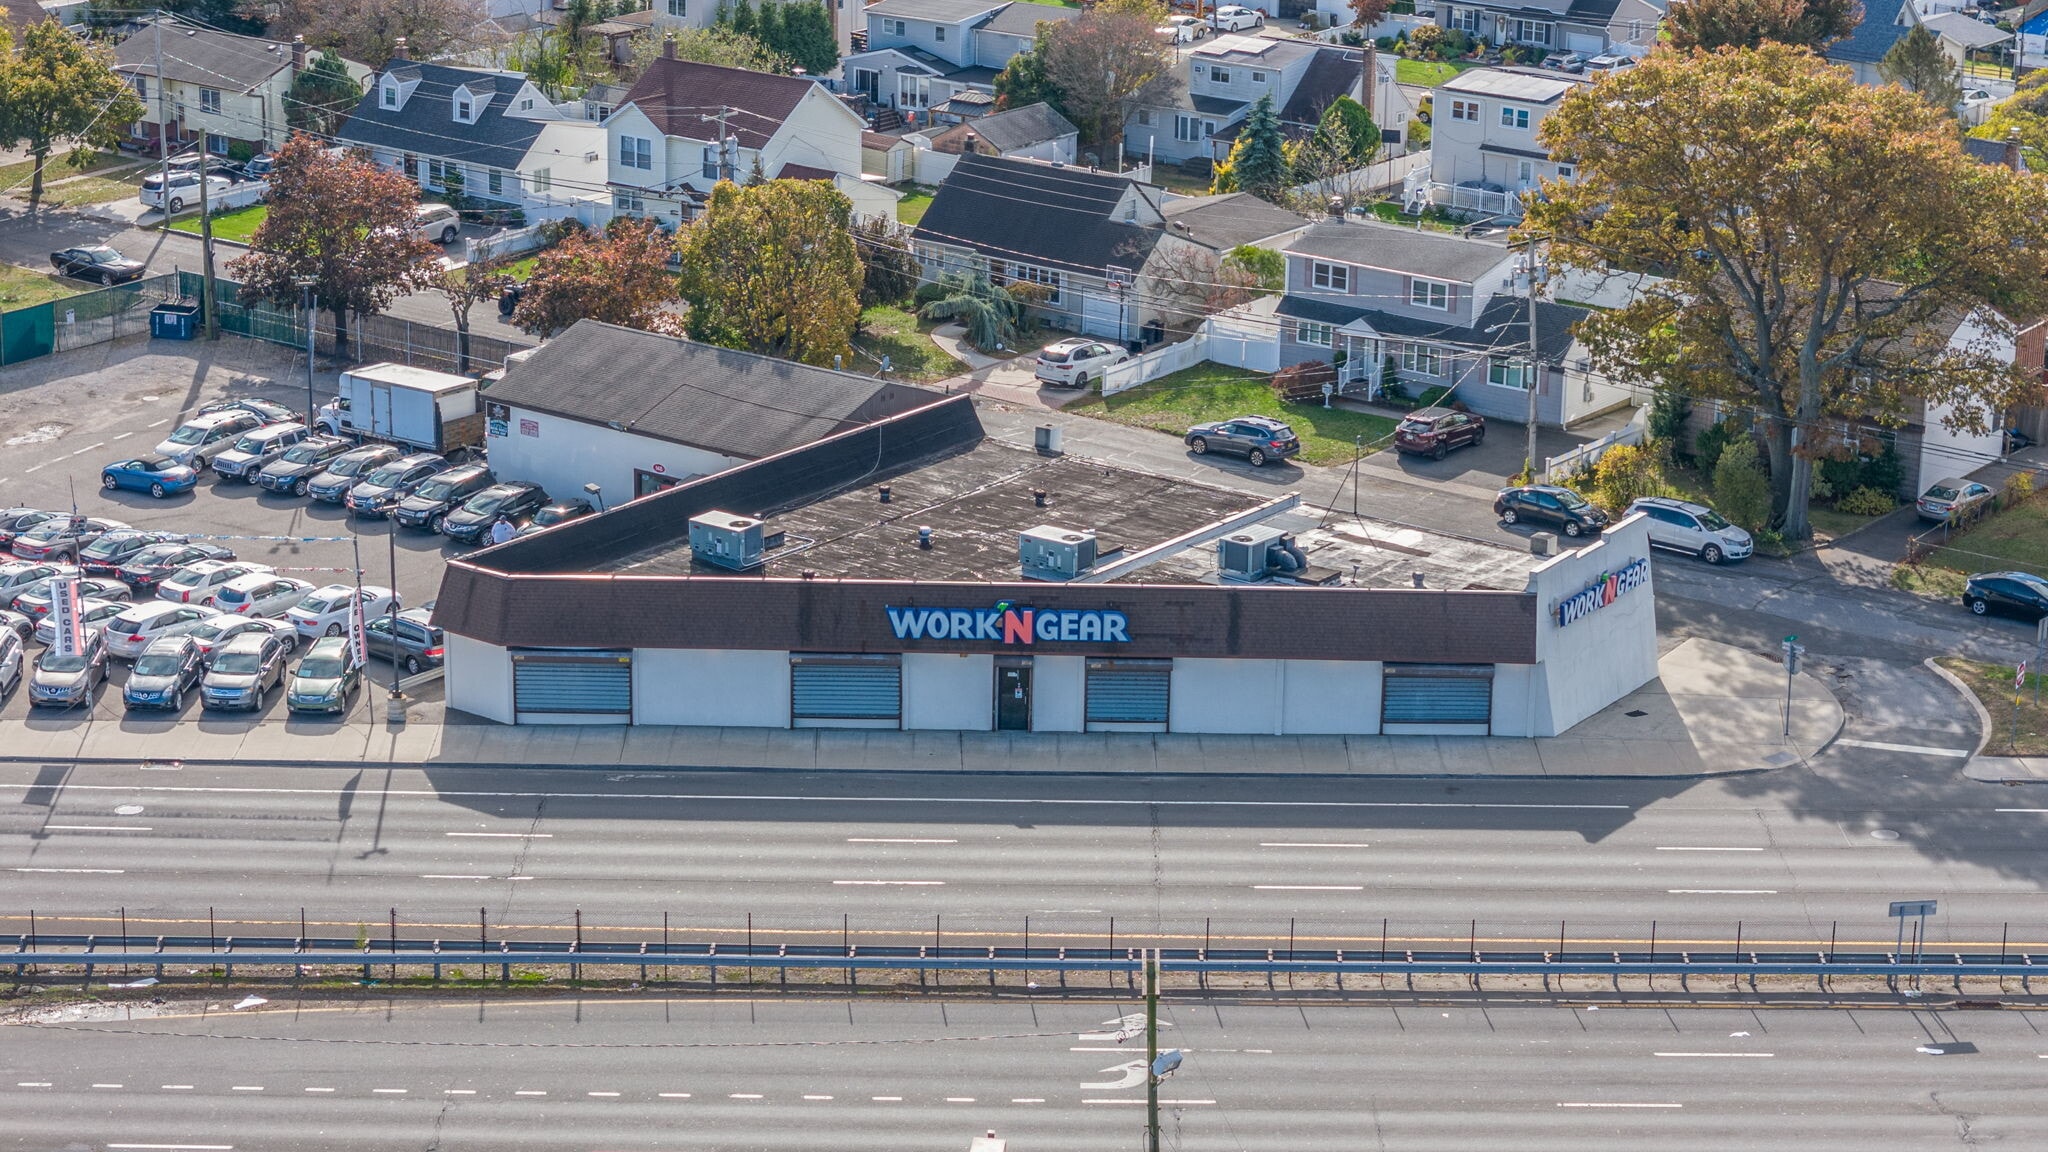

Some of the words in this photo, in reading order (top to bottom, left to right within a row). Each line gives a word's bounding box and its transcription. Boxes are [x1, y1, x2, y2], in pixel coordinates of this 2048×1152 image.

[59, 582, 69, 613] USED
[1561, 583, 1604, 627] WORK
[1617, 558, 1649, 596] GEAR
[63, 619, 72, 652] CARS
[887, 608, 1002, 640] WORK
[1035, 611, 1129, 642] GEAR
[354, 624, 362, 662] OWNED
